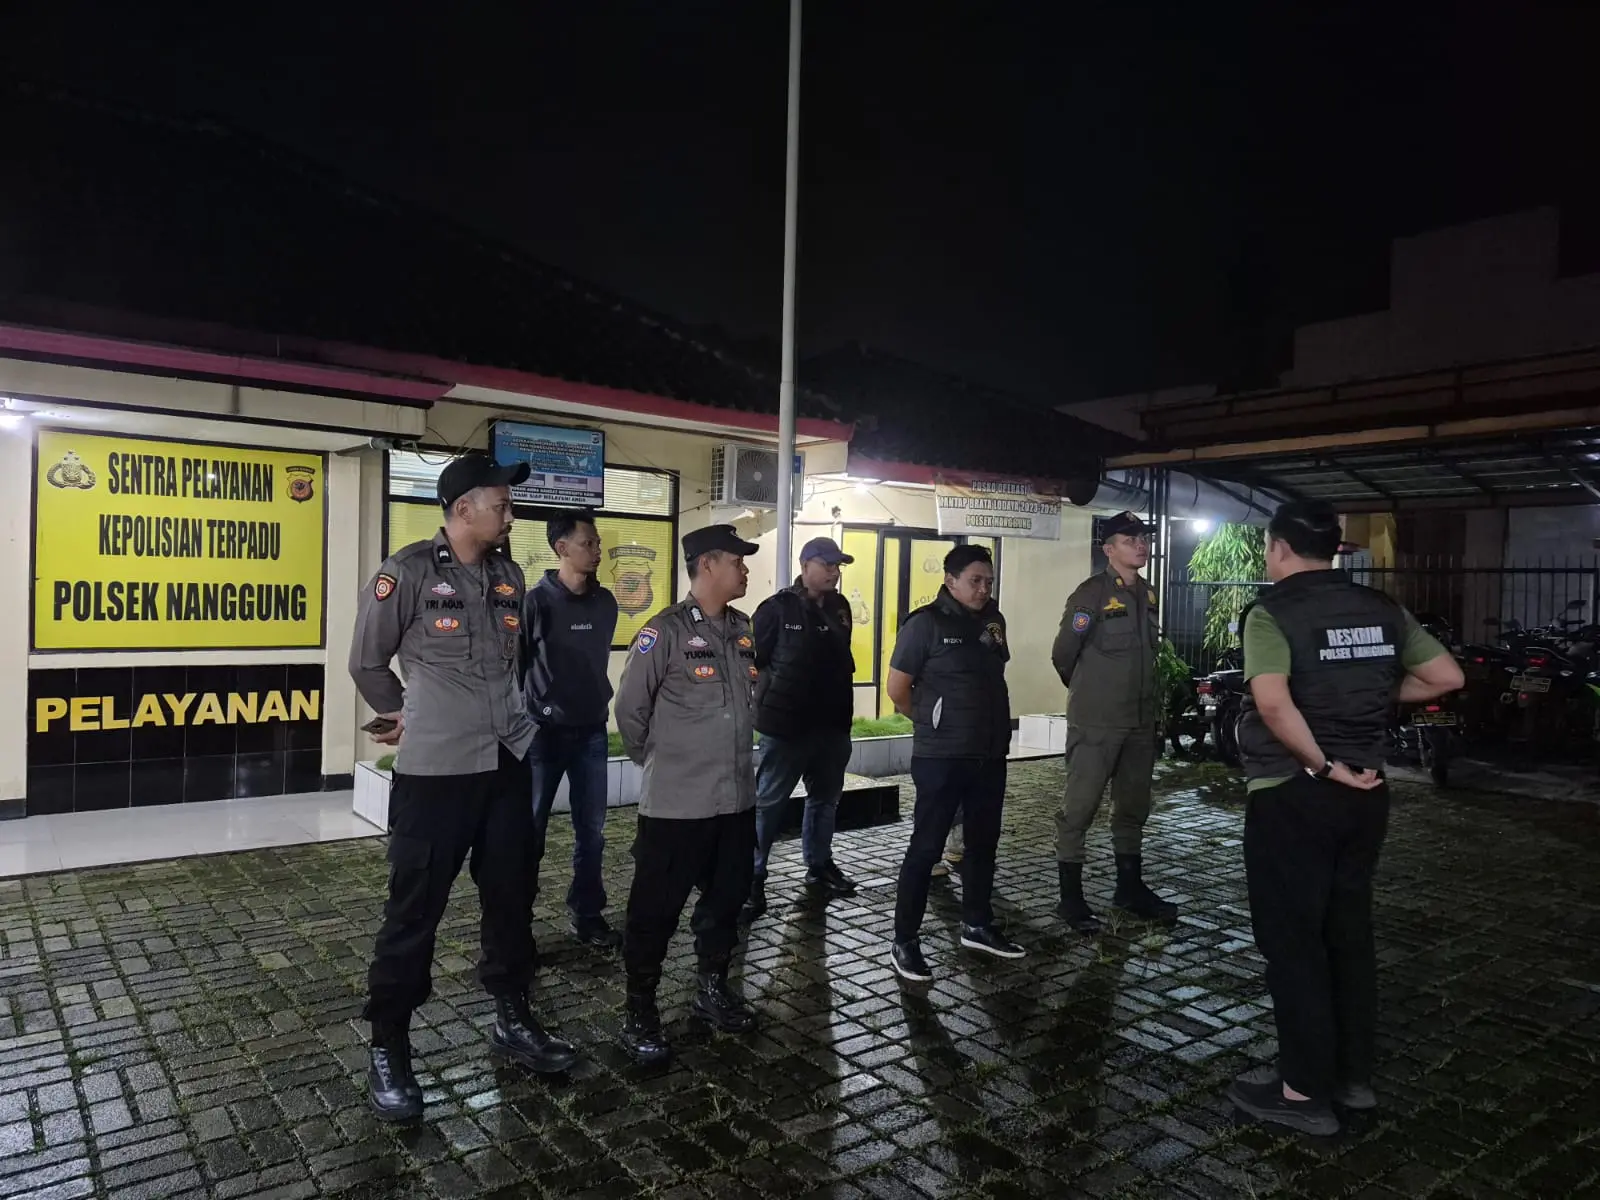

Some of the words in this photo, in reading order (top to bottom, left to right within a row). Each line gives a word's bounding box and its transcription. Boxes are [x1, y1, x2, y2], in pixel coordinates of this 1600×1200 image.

[108, 452, 177, 497] SENTRA
[182, 456, 273, 502] PELAYANAN
[99, 514, 202, 558] KEPOLISIAN
[207, 519, 280, 561] TERPADU
[53, 580, 159, 621] POLSEK
[166, 583, 307, 621] NANGGUNG
[425, 600, 438, 609] TRI
[441, 600, 464, 609] AGUS
[1320, 647, 1352, 660] POLSEK
[1326, 626, 1384, 647] RESKRIM
[36, 690, 320, 733] PELAYANAN
